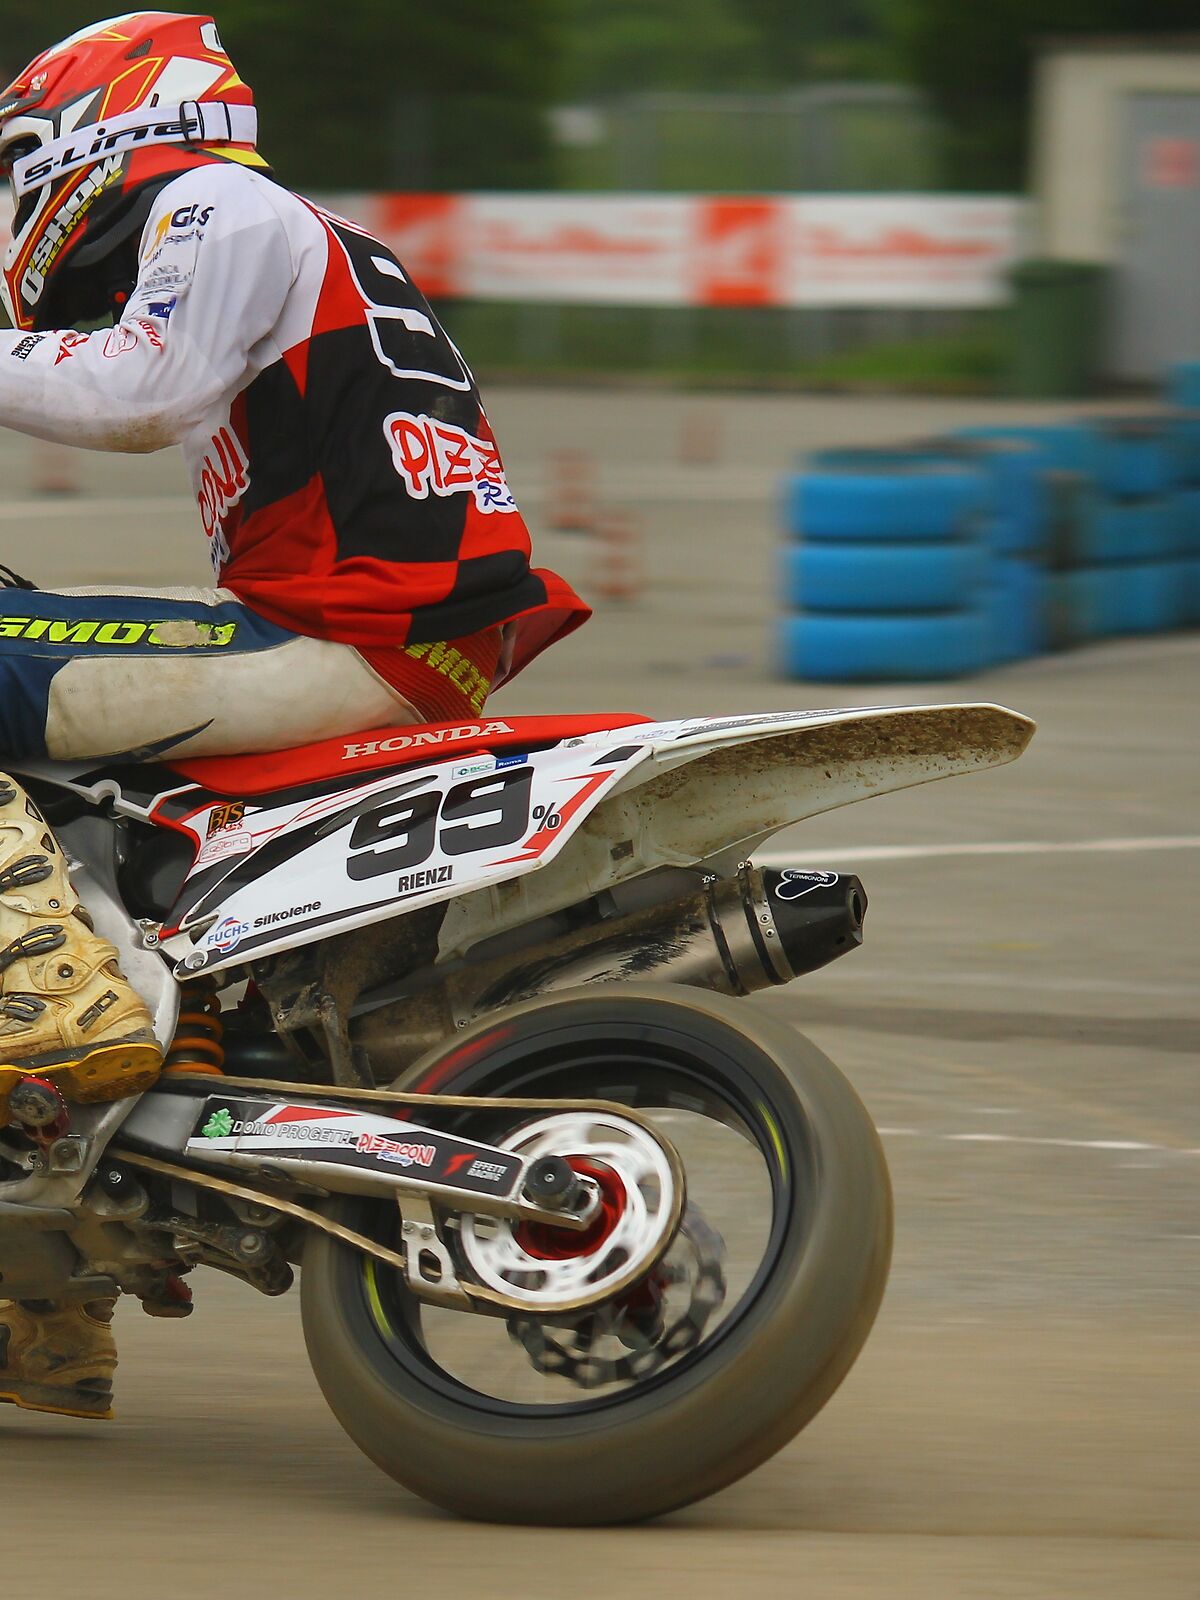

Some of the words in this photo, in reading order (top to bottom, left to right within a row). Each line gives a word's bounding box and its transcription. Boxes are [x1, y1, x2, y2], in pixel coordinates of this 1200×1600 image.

[390, 419, 507, 492] PIZZ
[341, 720, 515, 761] HONDA
[346, 765, 535, 881] 99
[398, 864, 454, 893] RIENZI
[207, 922, 250, 945] FUCHS
[232, 1120, 277, 1137] DOMO
[277, 1123, 354, 1145] PROGETTI
[358, 1132, 435, 1165] PIZZICONI
